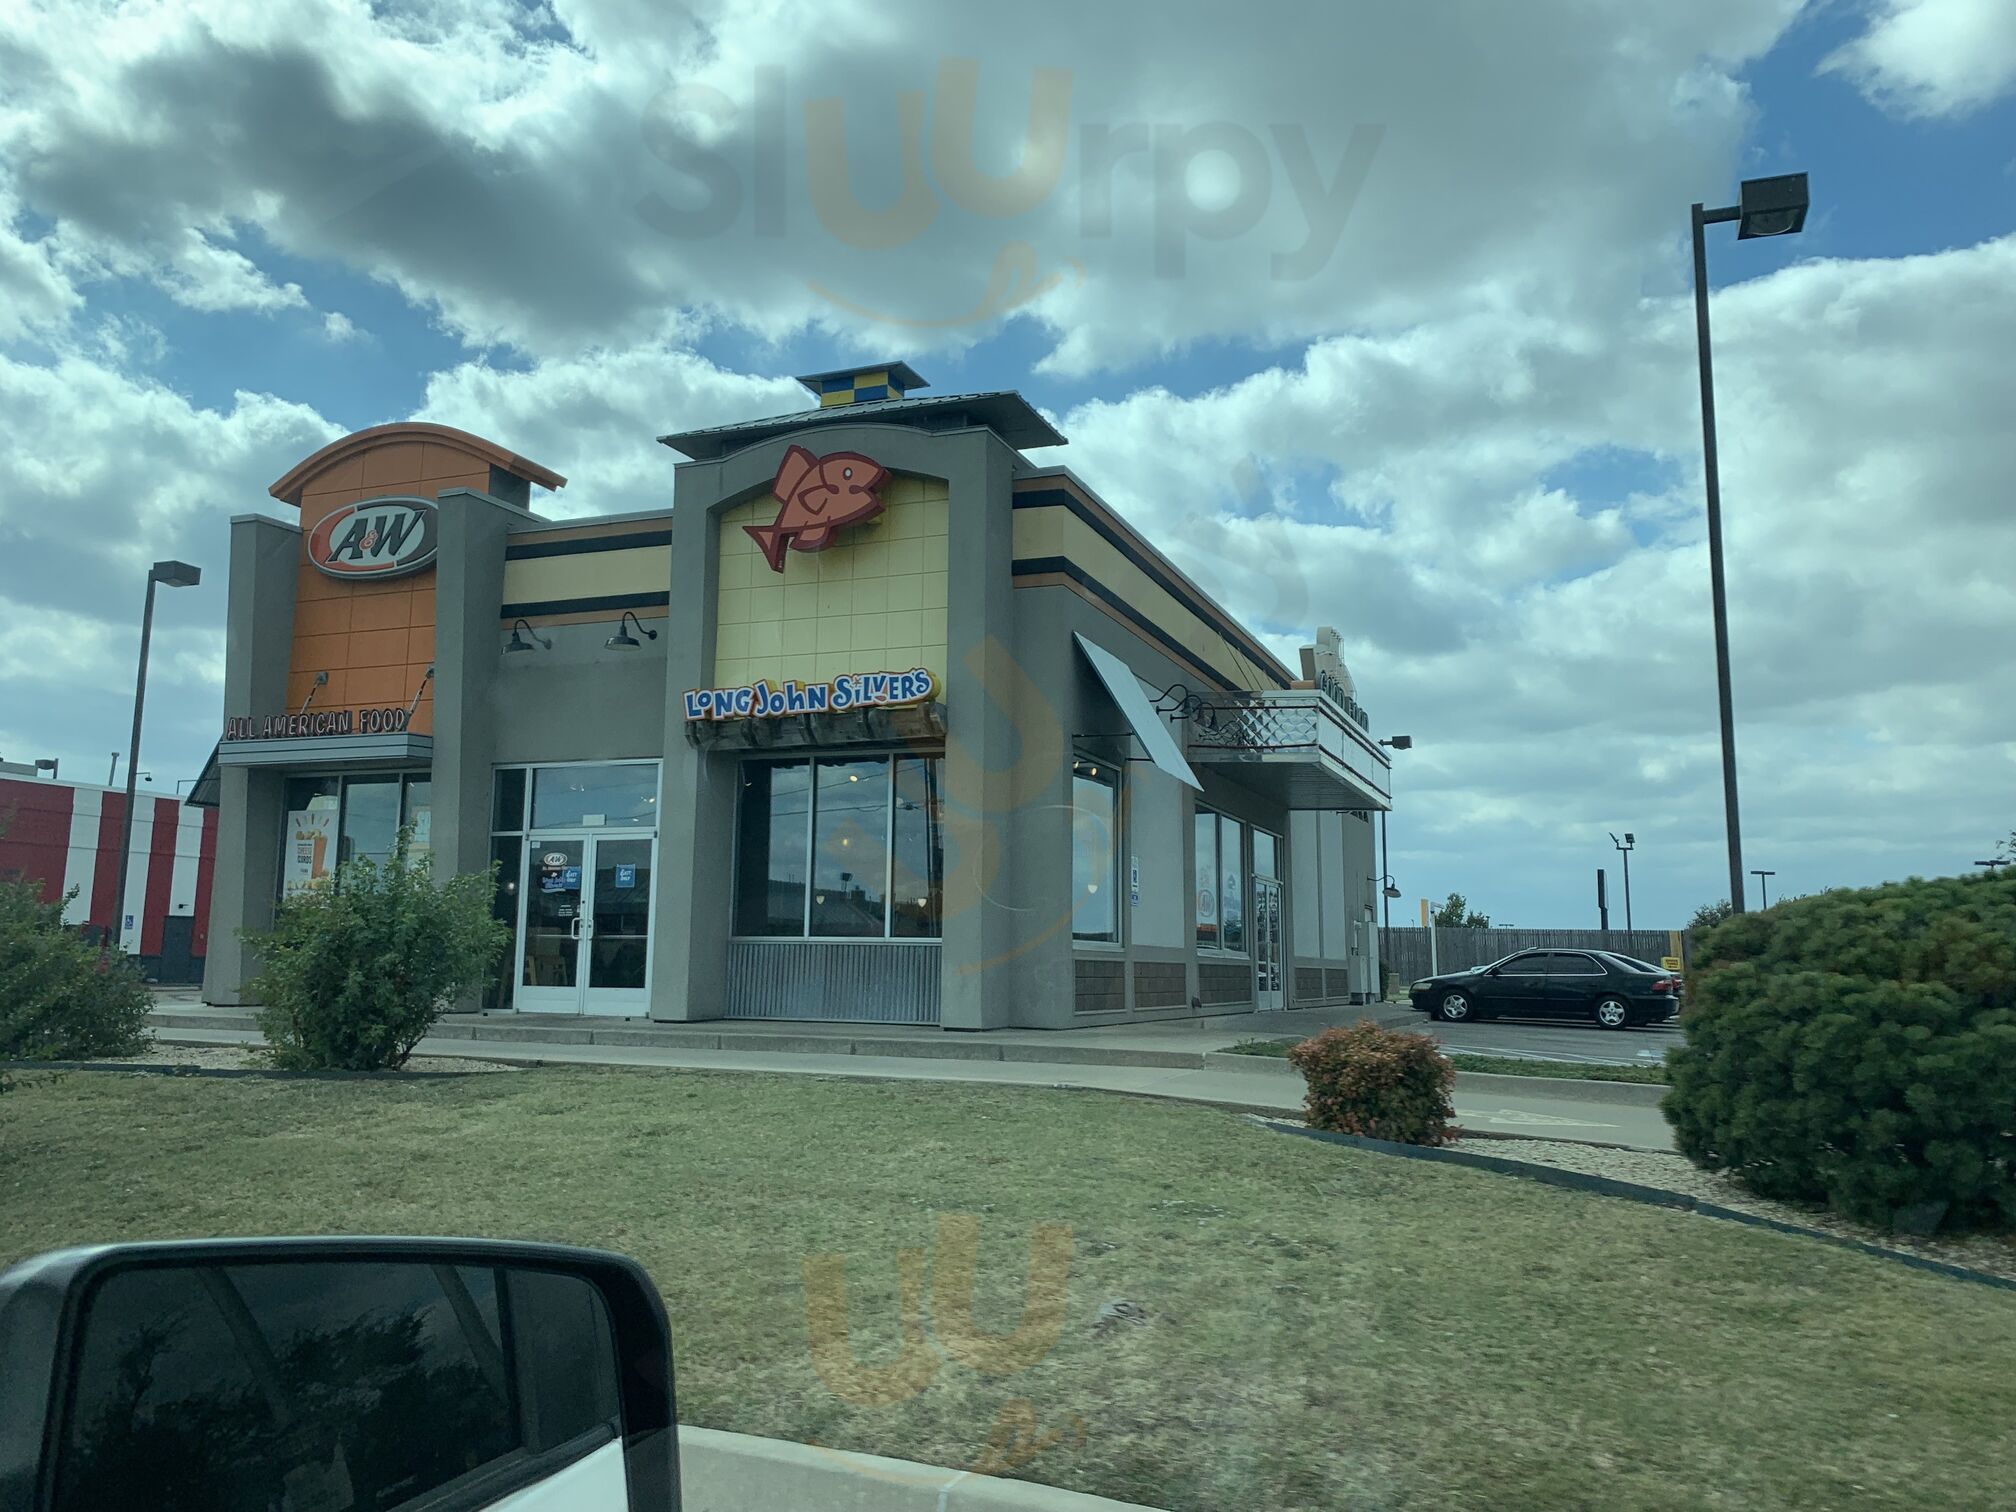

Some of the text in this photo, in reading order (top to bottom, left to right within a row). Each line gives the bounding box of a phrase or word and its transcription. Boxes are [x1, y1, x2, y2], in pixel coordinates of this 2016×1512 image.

[328, 508, 427, 564] A&W
[227, 707, 409, 740] ALL AMERICAN FOOD
